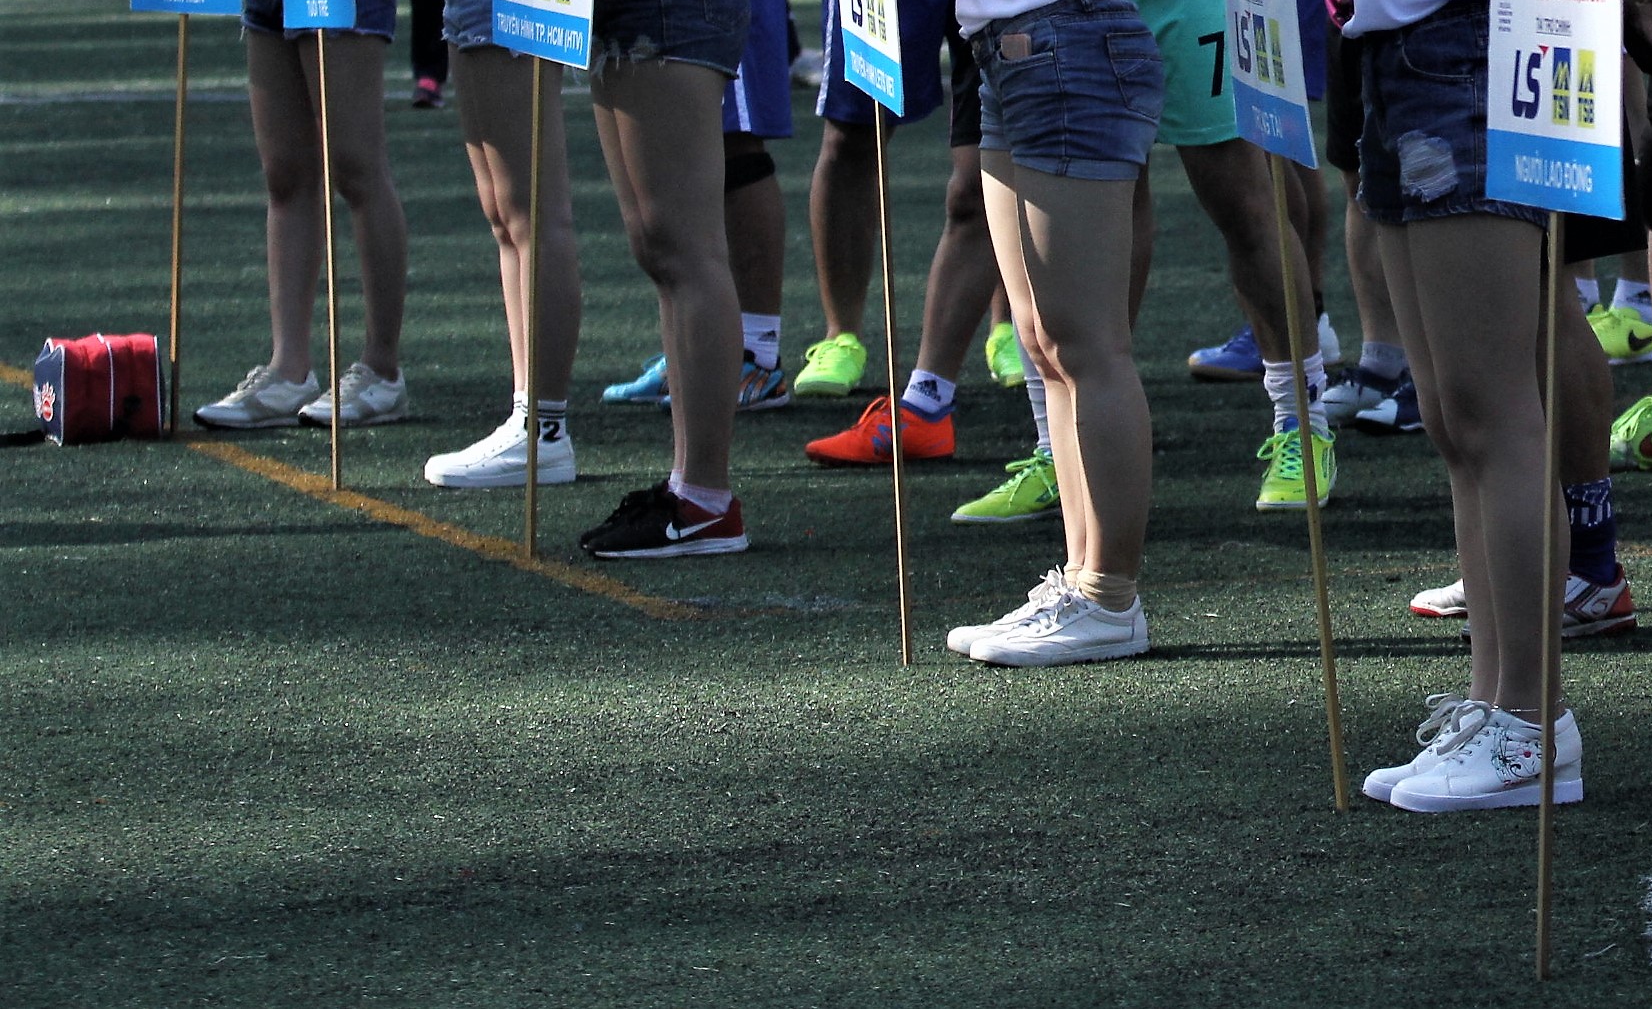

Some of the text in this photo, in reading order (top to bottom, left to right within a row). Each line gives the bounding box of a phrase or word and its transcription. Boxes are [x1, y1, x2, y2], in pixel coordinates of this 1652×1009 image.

[535, 22, 546, 43] TP.
[547, 26, 564, 47] HCM
[564, 27, 583, 55] (HTV)
[1198, 31, 1224, 97] 7
[1512, 49, 1541, 119] LS
